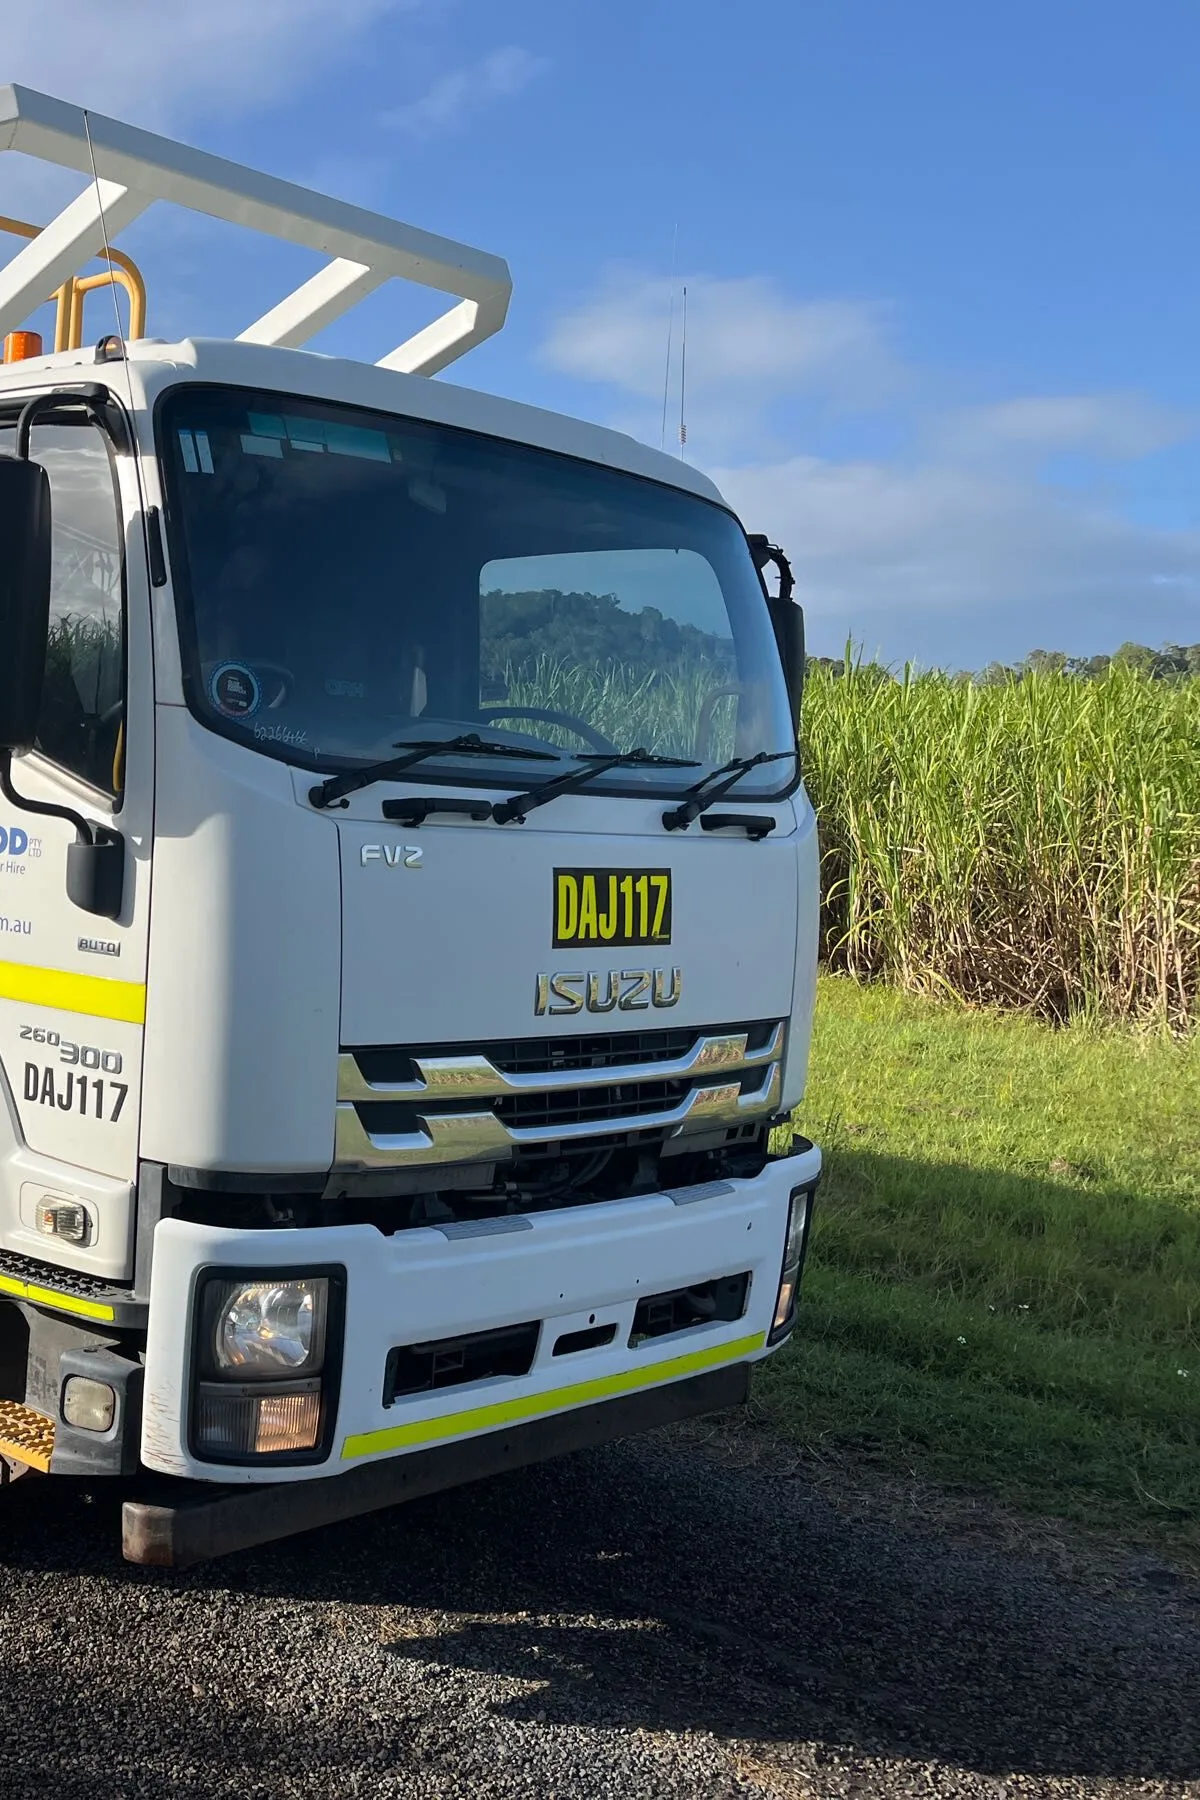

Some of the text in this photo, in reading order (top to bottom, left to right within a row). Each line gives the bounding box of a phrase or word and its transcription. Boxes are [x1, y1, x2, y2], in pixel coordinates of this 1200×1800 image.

[28, 848, 42, 858] LTD
[29, 838, 42, 847] PTY
[360, 844, 424, 868] FVZ
[6, 862, 26, 875] Hire
[557, 875, 668, 940] DAJ117
[78, 937, 117, 954] AUTO
[534, 966, 682, 1017] ISUZU
[19, 1024, 60, 1047] 260
[60, 1040, 123, 1075] 300
[24, 1061, 128, 1123] DAJ117
